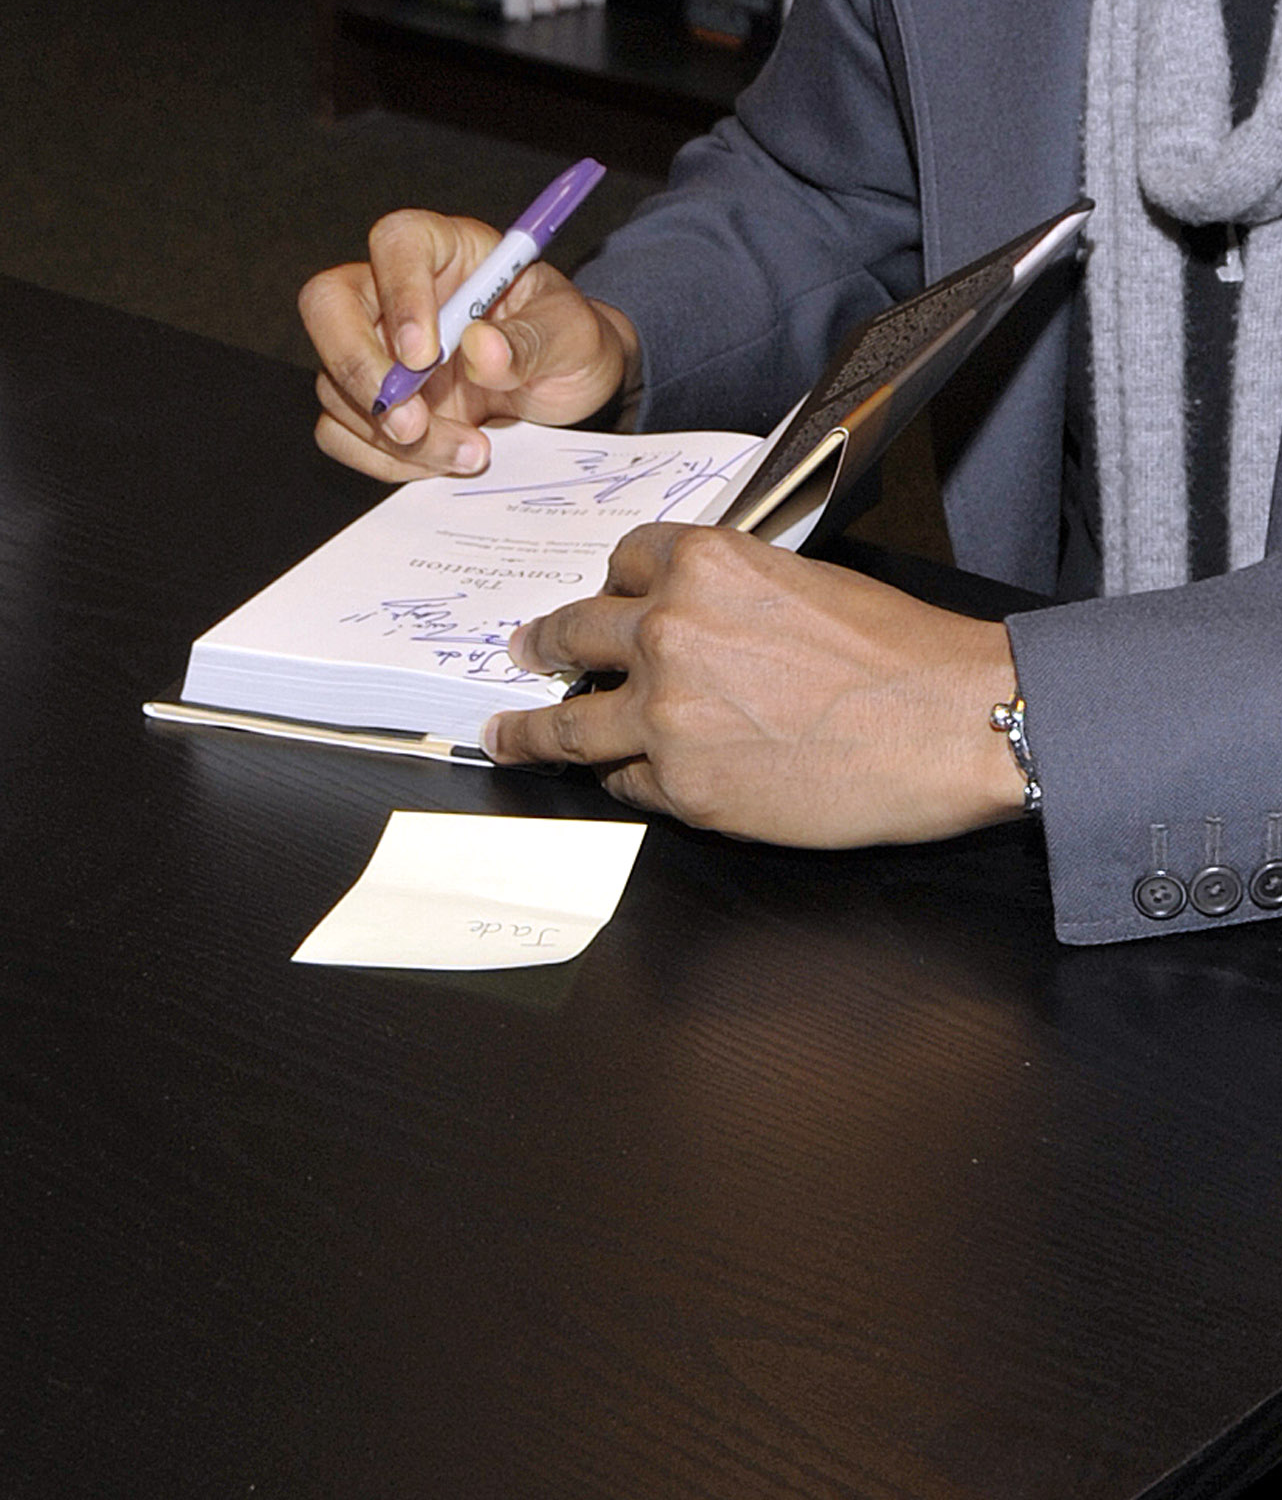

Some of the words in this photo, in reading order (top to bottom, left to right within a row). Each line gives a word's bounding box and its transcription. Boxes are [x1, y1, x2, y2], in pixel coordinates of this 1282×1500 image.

[505, 504, 589, 517] HARPER
[407, 557, 584, 586] Conversation
[460, 574, 503, 592] The
[466, 920, 560, 948] Jade
